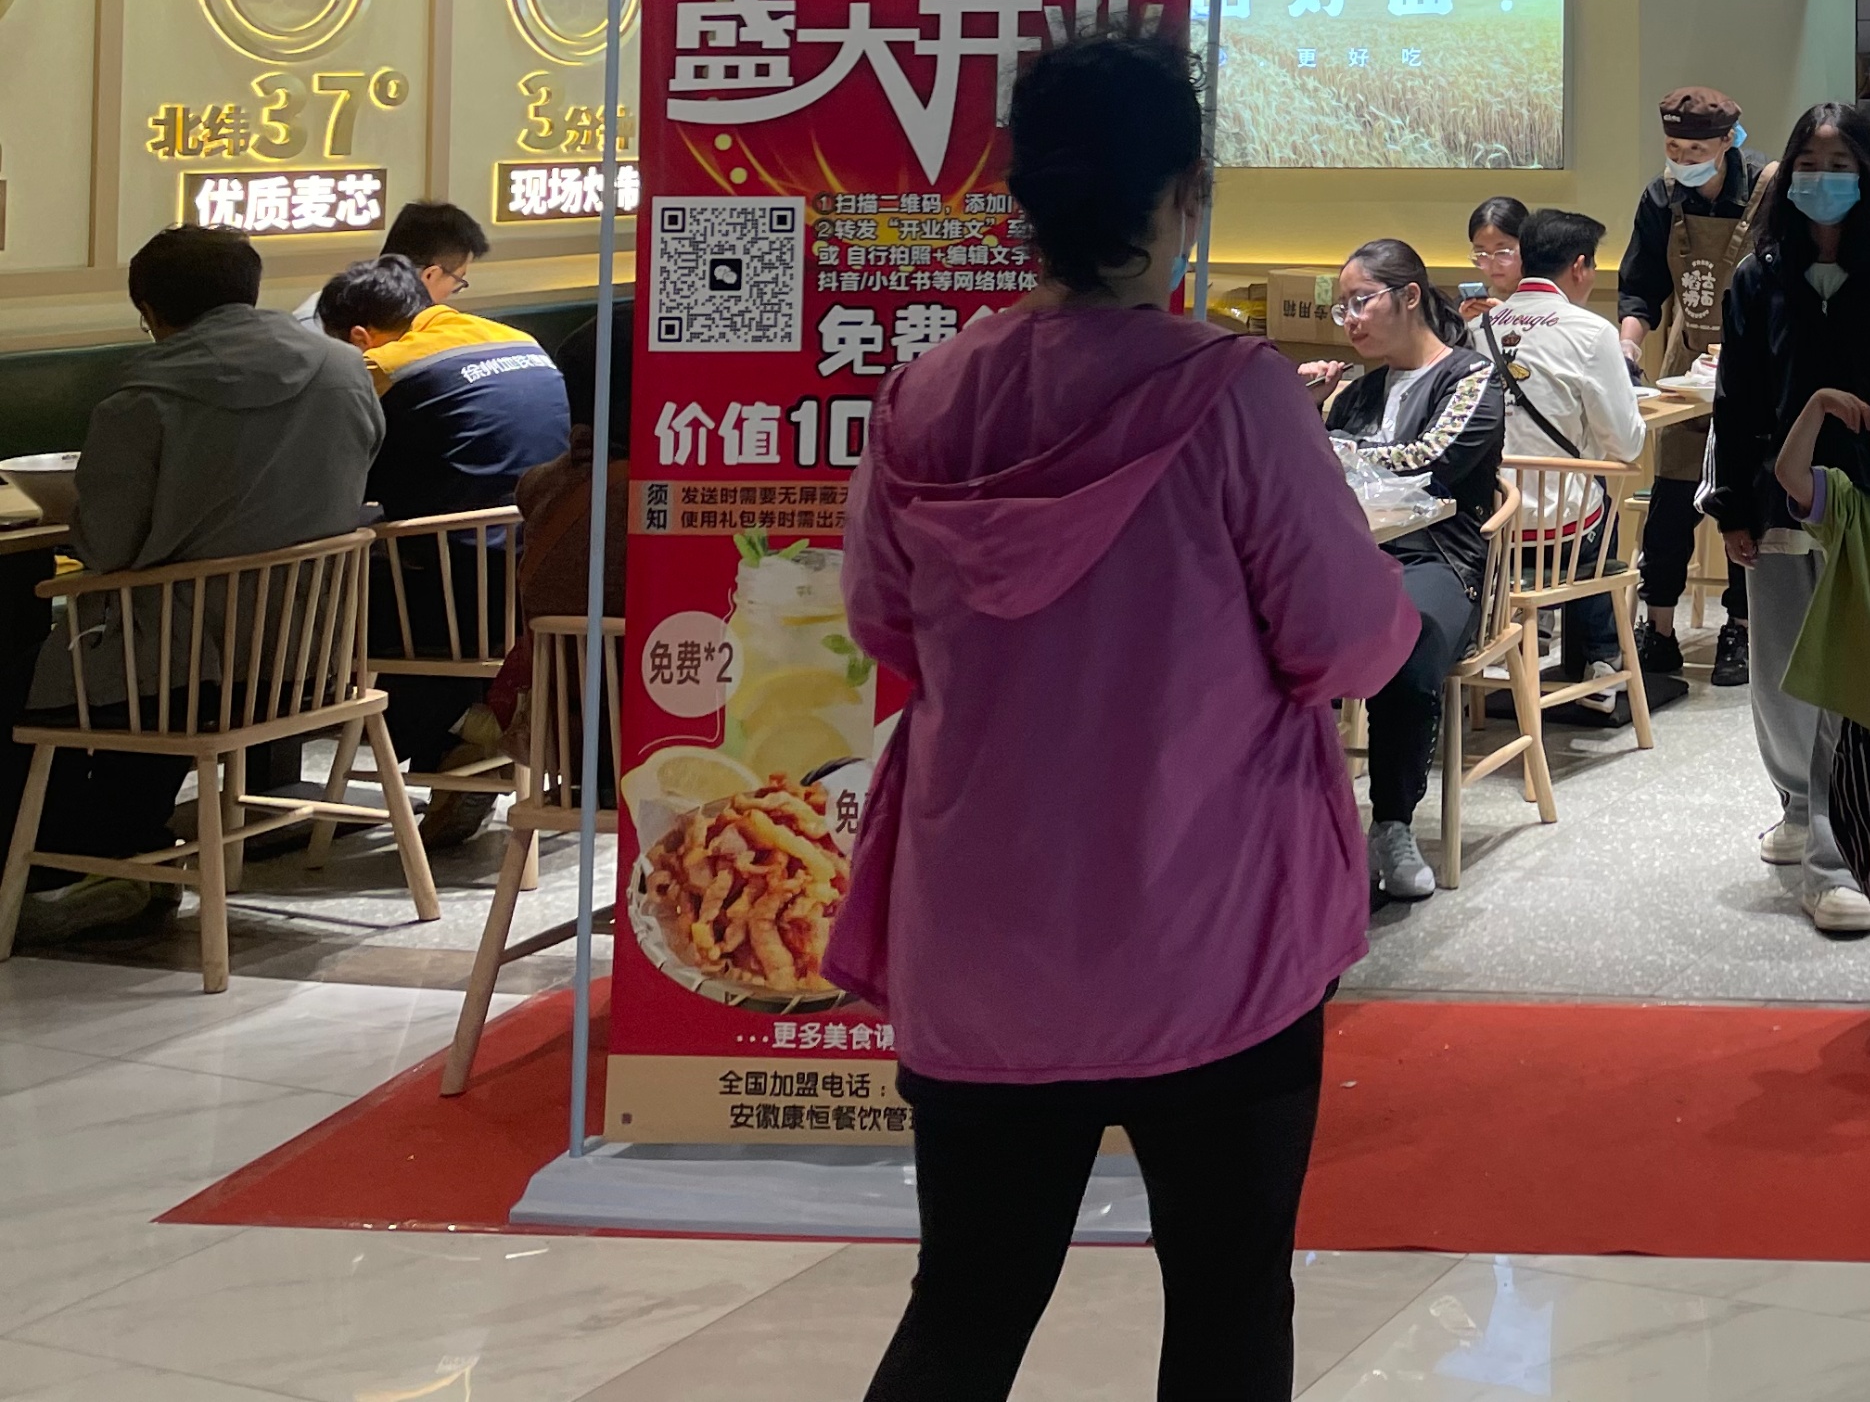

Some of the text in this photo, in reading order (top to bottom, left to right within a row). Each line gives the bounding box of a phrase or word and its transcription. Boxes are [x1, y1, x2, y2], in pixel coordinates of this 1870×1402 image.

[194, 171, 382, 232] 优质麦芯
[817, 271, 1038, 292] 抖音/小红书等网络媒体
